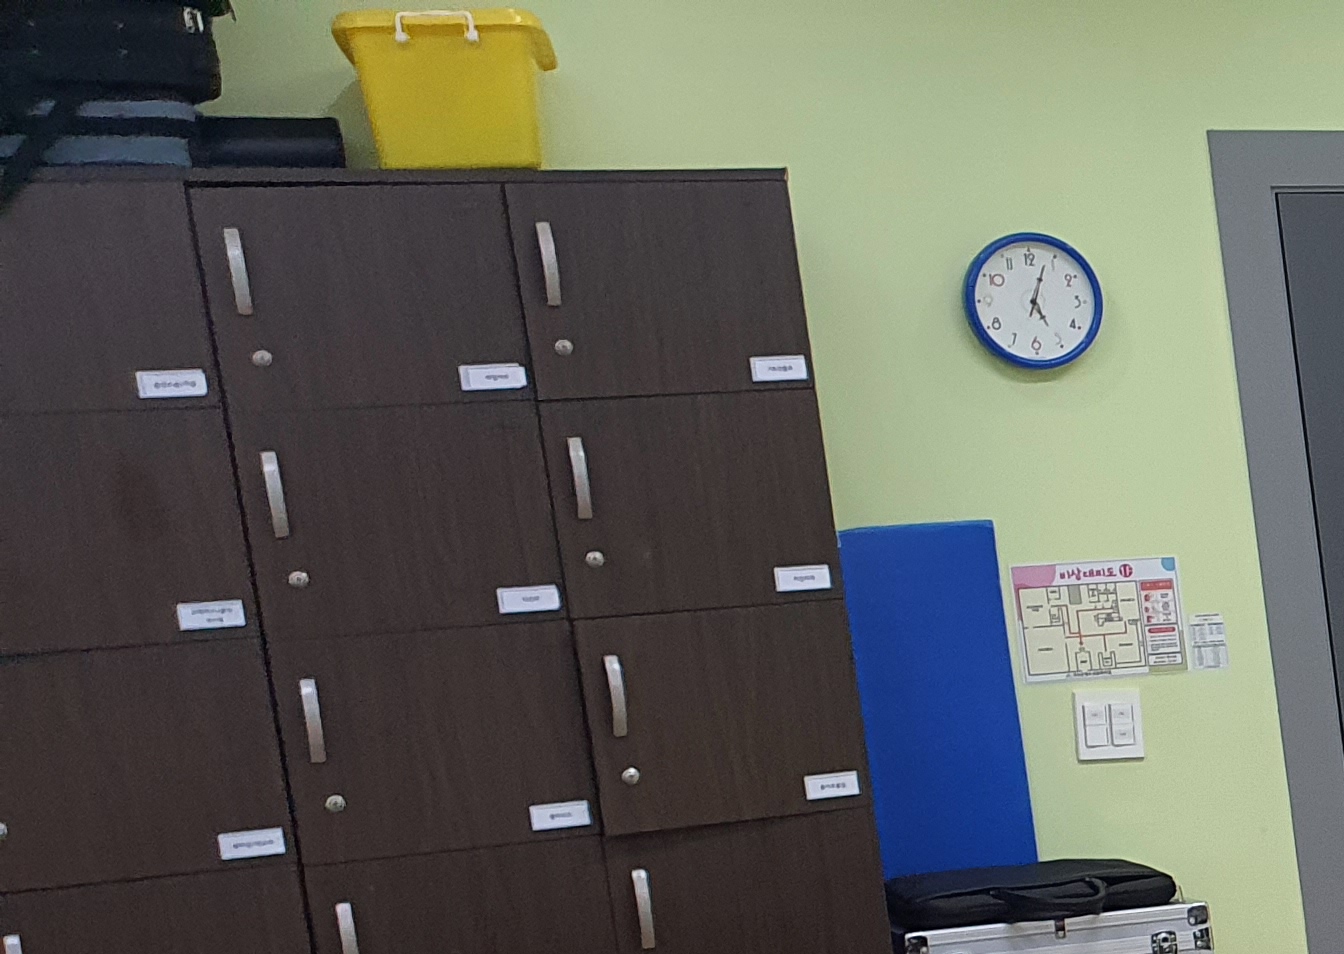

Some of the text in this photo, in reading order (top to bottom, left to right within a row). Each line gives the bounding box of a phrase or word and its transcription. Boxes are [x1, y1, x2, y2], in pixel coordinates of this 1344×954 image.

[1005, 257, 1014, 271] 11
[1023, 252, 1036, 267] 12
[988, 273, 1006, 287] 10
[1064, 273, 1072, 288] 2
[1074, 295, 1082, 309] 3
[991, 316, 1002, 331] 8
[1069, 317, 1077, 330] 4
[1031, 335, 1042, 351] 6
